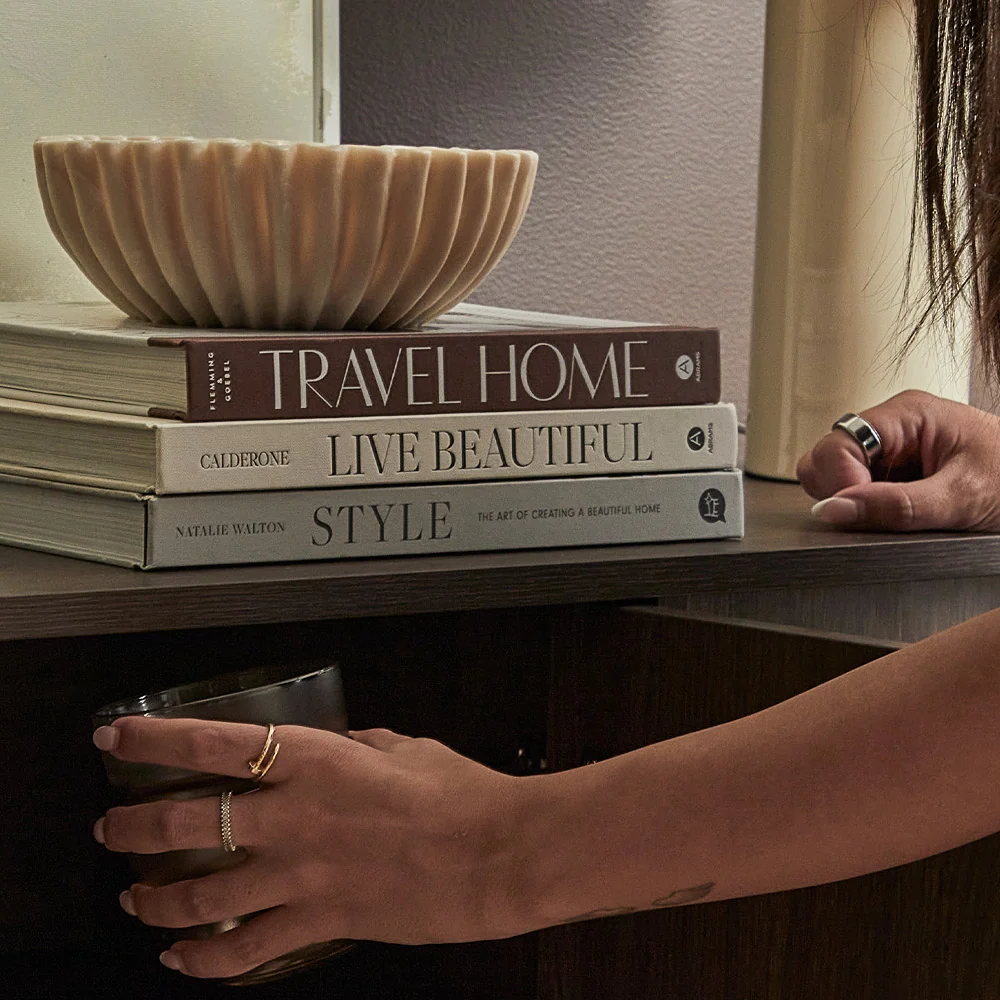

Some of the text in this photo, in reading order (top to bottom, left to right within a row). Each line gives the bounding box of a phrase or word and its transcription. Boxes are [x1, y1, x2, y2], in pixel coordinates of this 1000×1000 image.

[208, 351, 216, 411] FLEMMING
[223, 359, 232, 402] GOEBEL
[258, 340, 650, 410] TRAVEL HOME
[327, 421, 653, 477] LIVE BEAUTIFUL
[707, 421, 715, 454] ABRAMS
[200, 450, 291, 470] CALDERONE
[175, 521, 286, 539] NATALIE WALTON
[311, 501, 453, 547] STYLE
[477, 503, 661, 522] THE ART OF CREATING A BEAUTIFUL HOME
